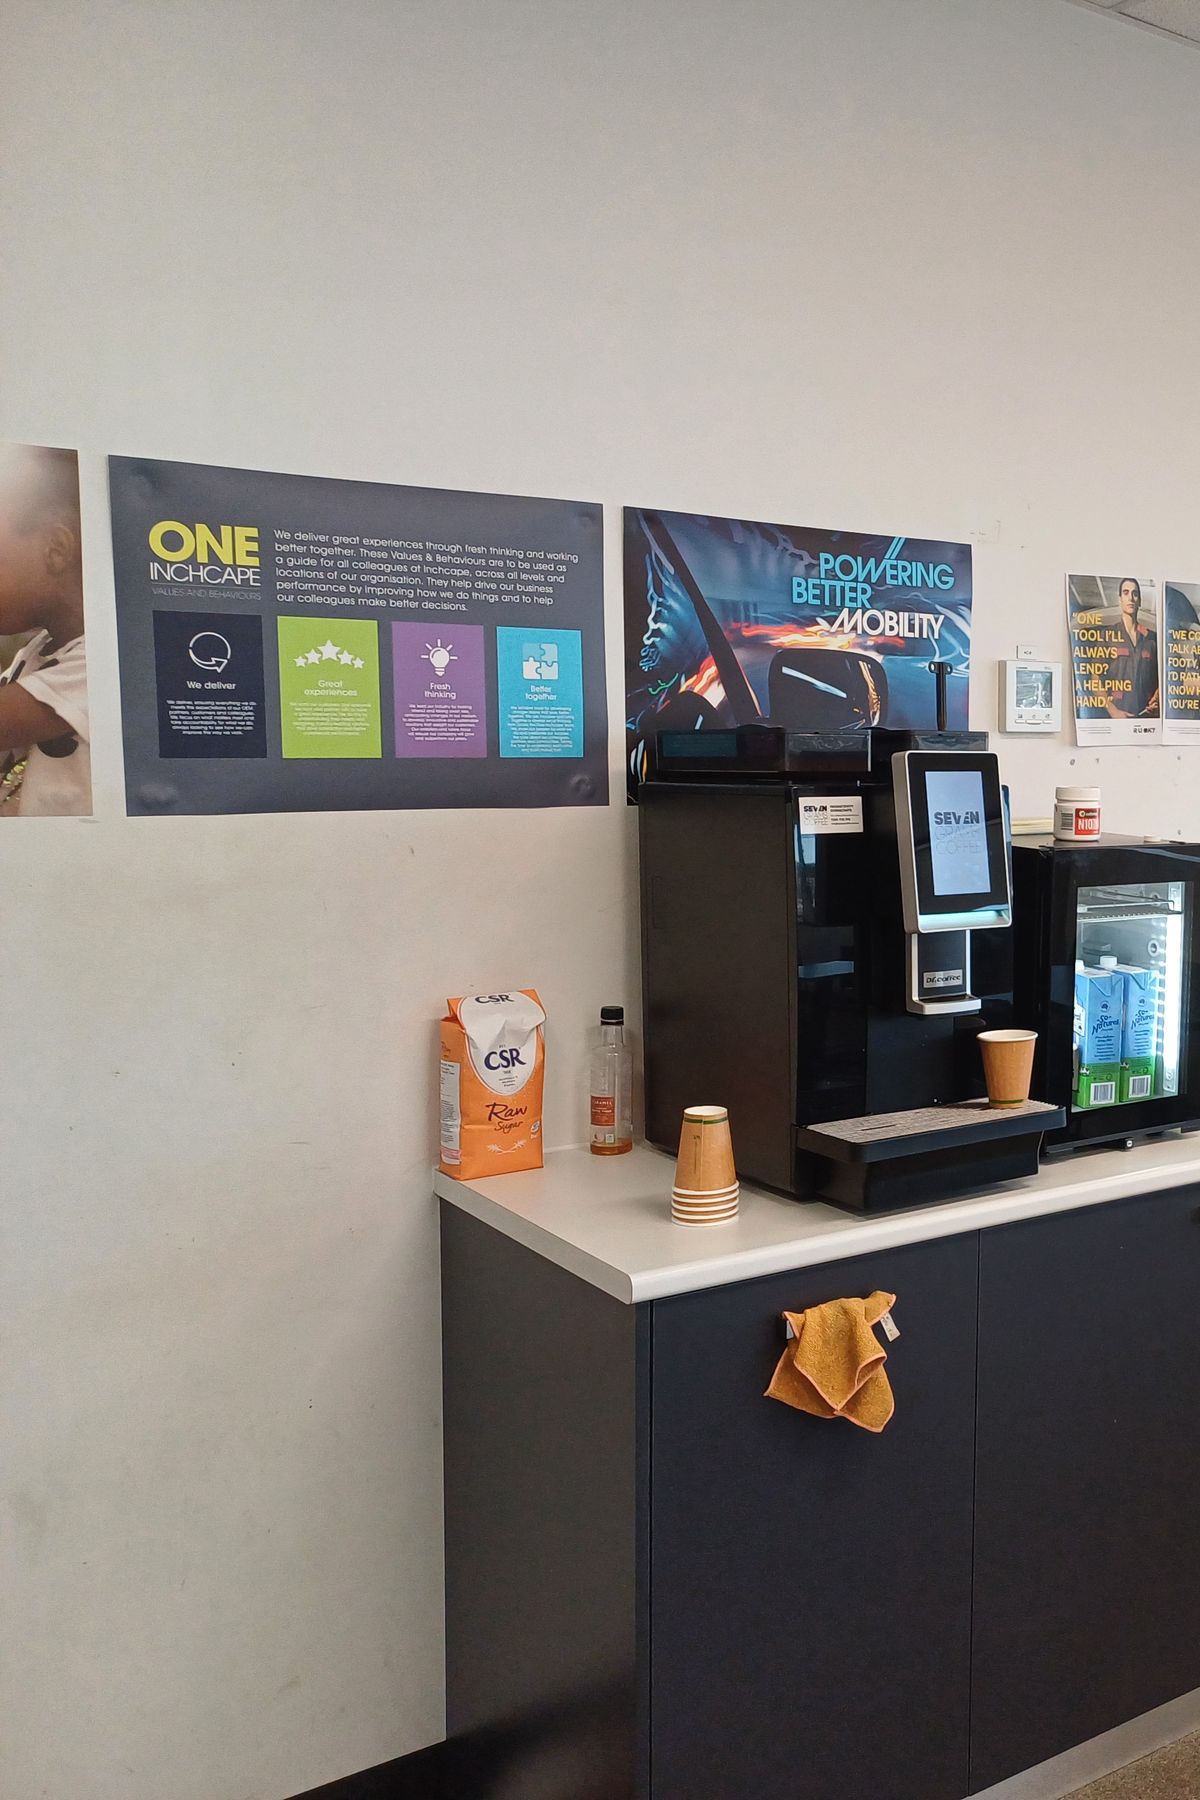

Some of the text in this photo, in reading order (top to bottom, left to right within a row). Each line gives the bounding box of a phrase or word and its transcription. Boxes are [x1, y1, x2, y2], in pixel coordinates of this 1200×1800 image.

[148, 520, 260, 567] ONE
[274, 530, 579, 564] We deliver great experiences through fresh thinking and working
[275, 542, 567, 572] better together. These Values & Behaviours are to be used as
[275, 556, 565, 583] a guide for all colleagues at Inchcape, across all levels and
[819, 540, 955, 591] POWERING
[150, 562, 262, 586] INCHCAPE
[275, 567, 554, 593] locations of our organisation. They help drive our business
[276, 581, 554, 606] performance by improving how we do things and to help
[792, 577, 871, 609] BETTER
[277, 593, 468, 612] our colleagues make better decisions.
[830, 608, 945, 640] MOBILITY
[1072, 629, 1124, 642] TOOL I'LL
[1073, 646, 1118, 658] ALWAYS
[1168, 643, 1189, 654] TALK
[1074, 663, 1109, 675] LEND?
[1168, 658, 1199, 670] FOOTY,
[186, 680, 236, 690] We deliver
[318, 680, 343, 688] Great
[430, 682, 451, 690] Fresh
[531, 685, 552, 693] Better
[1075, 680, 1132, 692] A HELPING
[1168, 685, 1195, 696] KNOW
[304, 689, 358, 697] experiences
[424, 690, 456, 700] thinking
[525, 693, 557, 701] together
[934, 811, 980, 826] SEVEN
[475, 994, 515, 1004] CSR
[484, 1048, 527, 1071] CSR
[485, 1102, 528, 1121] Raw
[494, 1121, 524, 1134] Sugar
